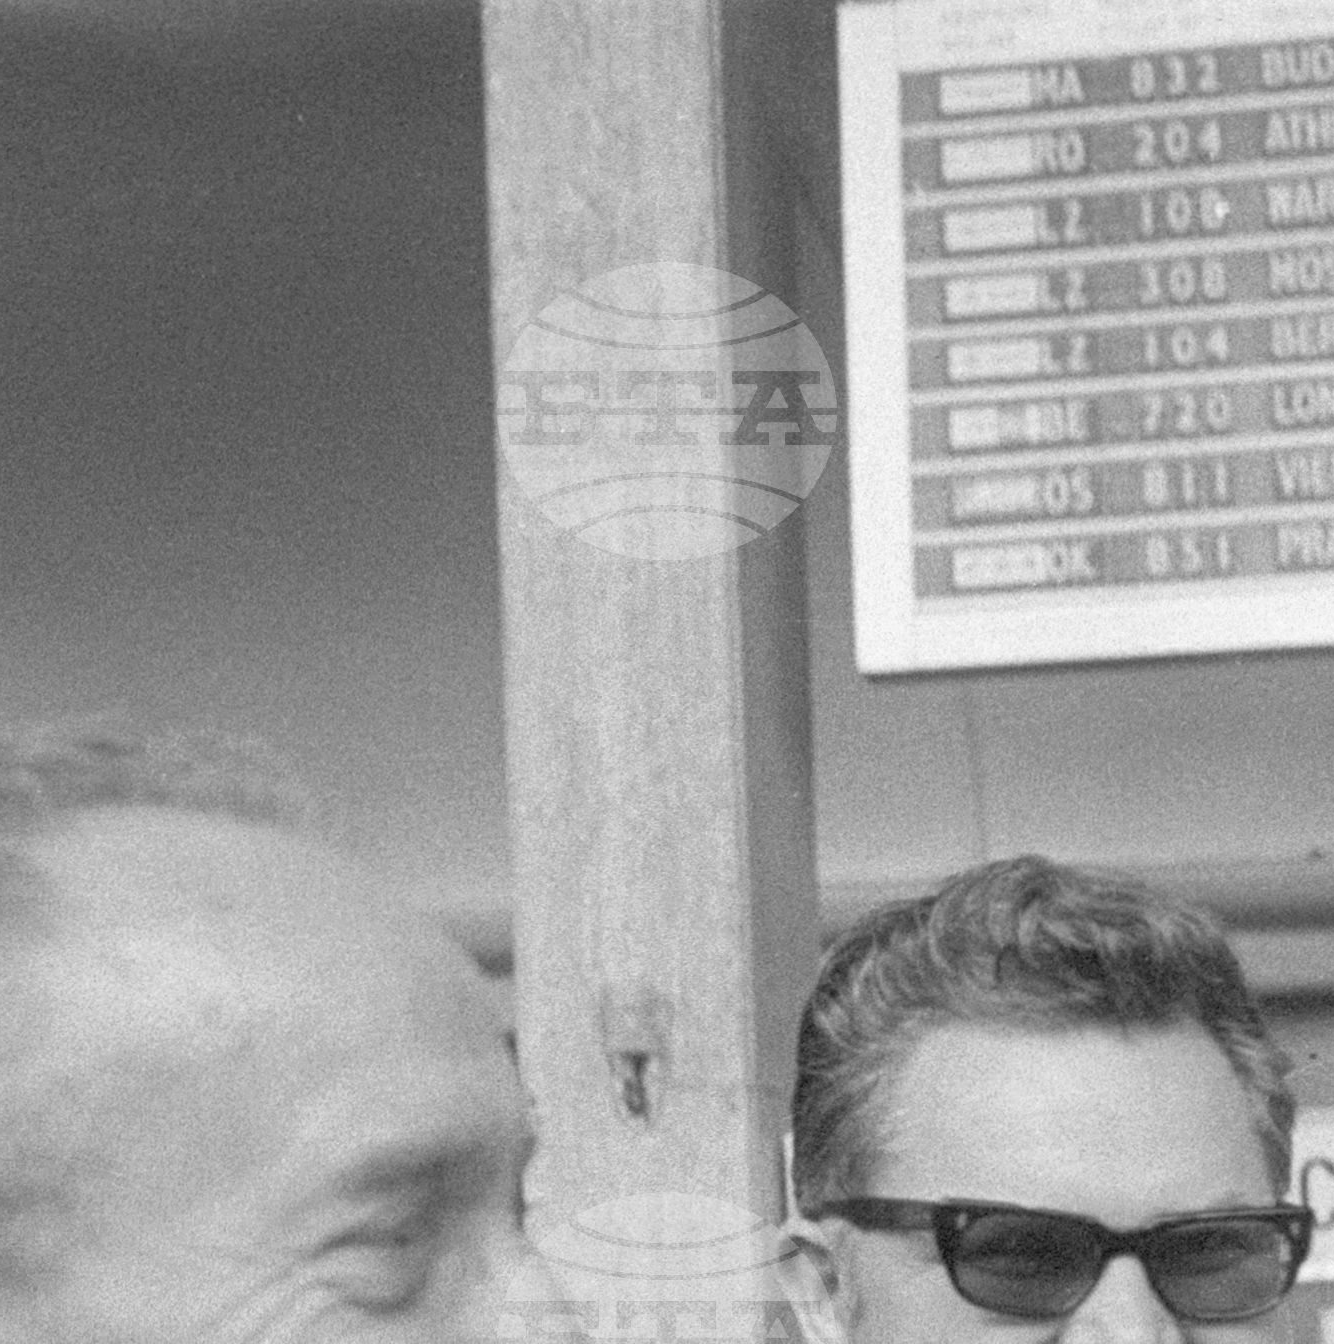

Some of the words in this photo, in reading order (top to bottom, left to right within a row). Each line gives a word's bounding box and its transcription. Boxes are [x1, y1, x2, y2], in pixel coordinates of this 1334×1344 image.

[1133, 121, 1223, 167] 204
[1144, 326, 1229, 366] 104
[1144, 391, 1232, 434] 720
